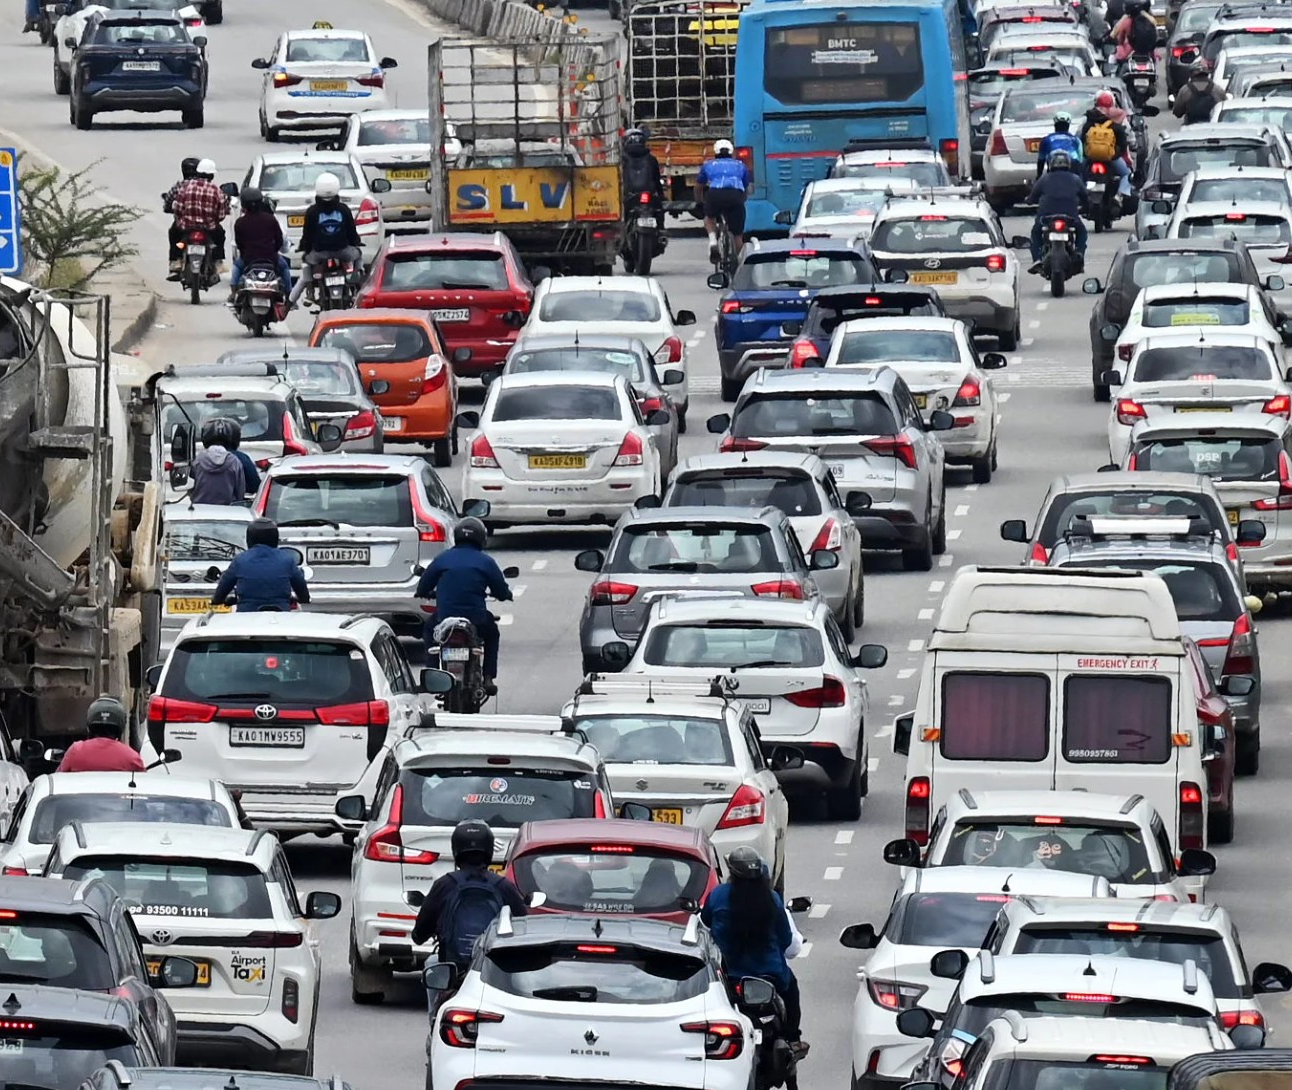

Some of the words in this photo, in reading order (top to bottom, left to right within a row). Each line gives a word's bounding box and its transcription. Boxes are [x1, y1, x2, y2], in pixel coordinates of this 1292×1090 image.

[828, 38, 857, 49] BMTC
[1197, 452, 1220, 462] DSP
[1077, 658, 1127, 669] EMERGENCY
[1130, 659, 1149, 669] EXIT
[238, 729, 303, 743] KA01MW9555
[146, 905, 178, 915] 93500
[181, 906, 209, 917] 11111
[231, 956, 267, 967] Airport
[231, 966, 266, 983] Taxi
